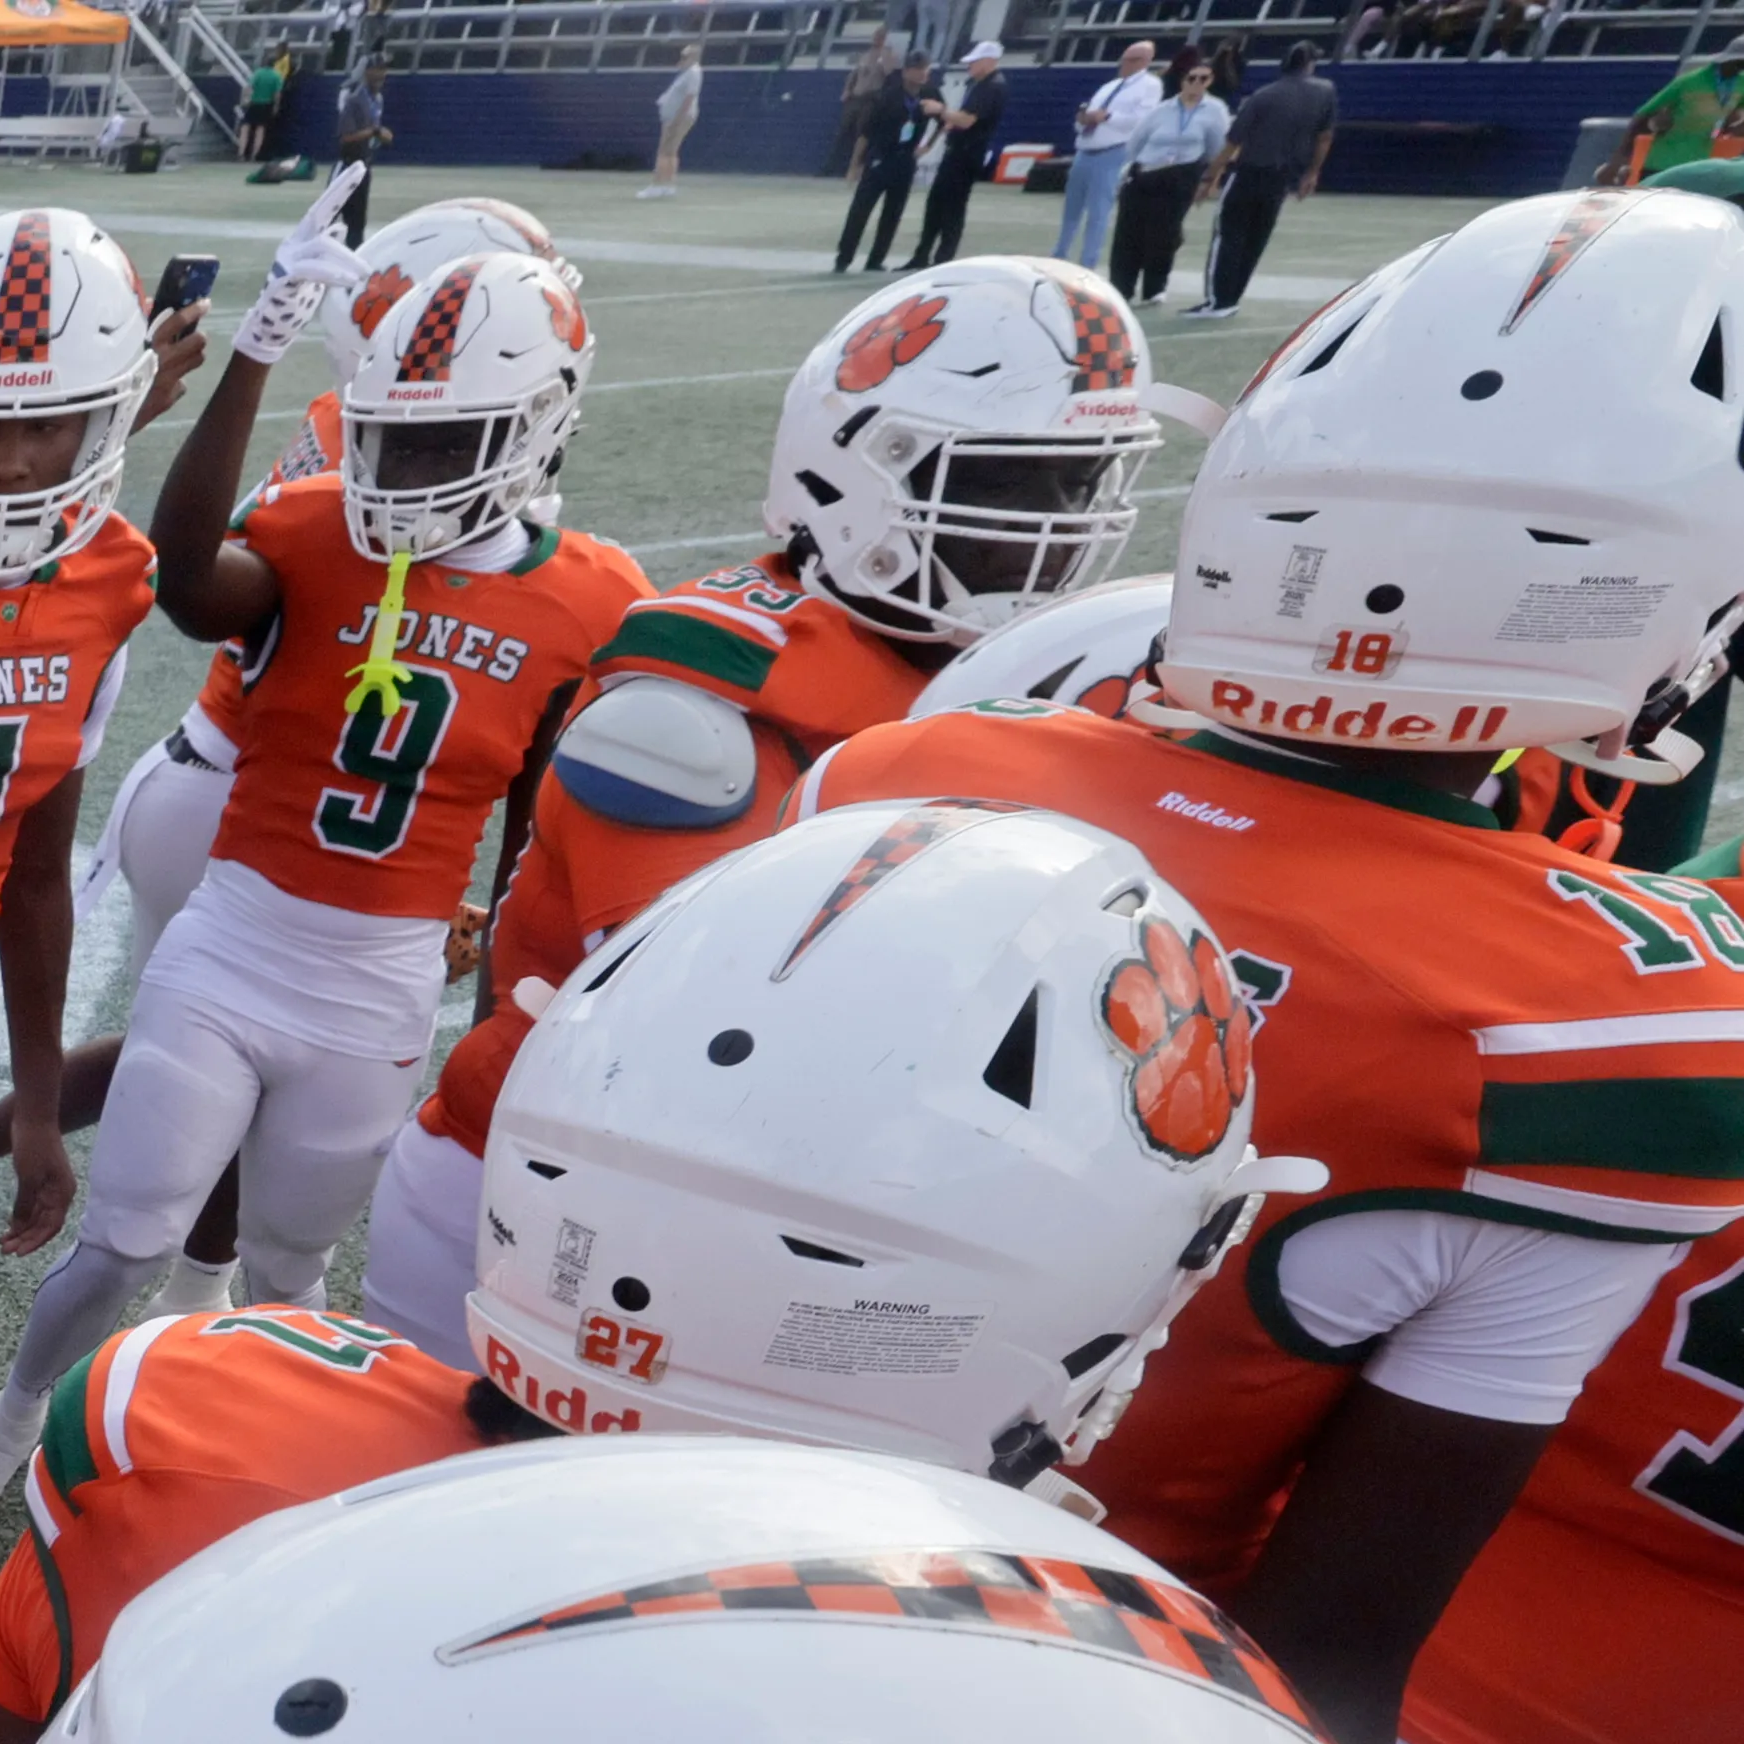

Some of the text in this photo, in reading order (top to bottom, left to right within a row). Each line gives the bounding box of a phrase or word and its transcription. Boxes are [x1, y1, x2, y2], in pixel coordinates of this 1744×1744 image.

[387, 386, 445, 401] Riddell
[1579, 576, 1639, 586] WARNING
[337, 603, 531, 684] JONES
[1325, 629, 1393, 675] 18
[1211, 679, 1509, 743] Riddell
[312, 665, 459, 861] 9
[1156, 791, 1255, 834] Riddell
[1546, 868, 1744, 976] 18
[853, 1299, 931, 1315] WARNING
[582, 1315, 664, 1381] 27
[486, 1333, 642, 1435] Ridd
